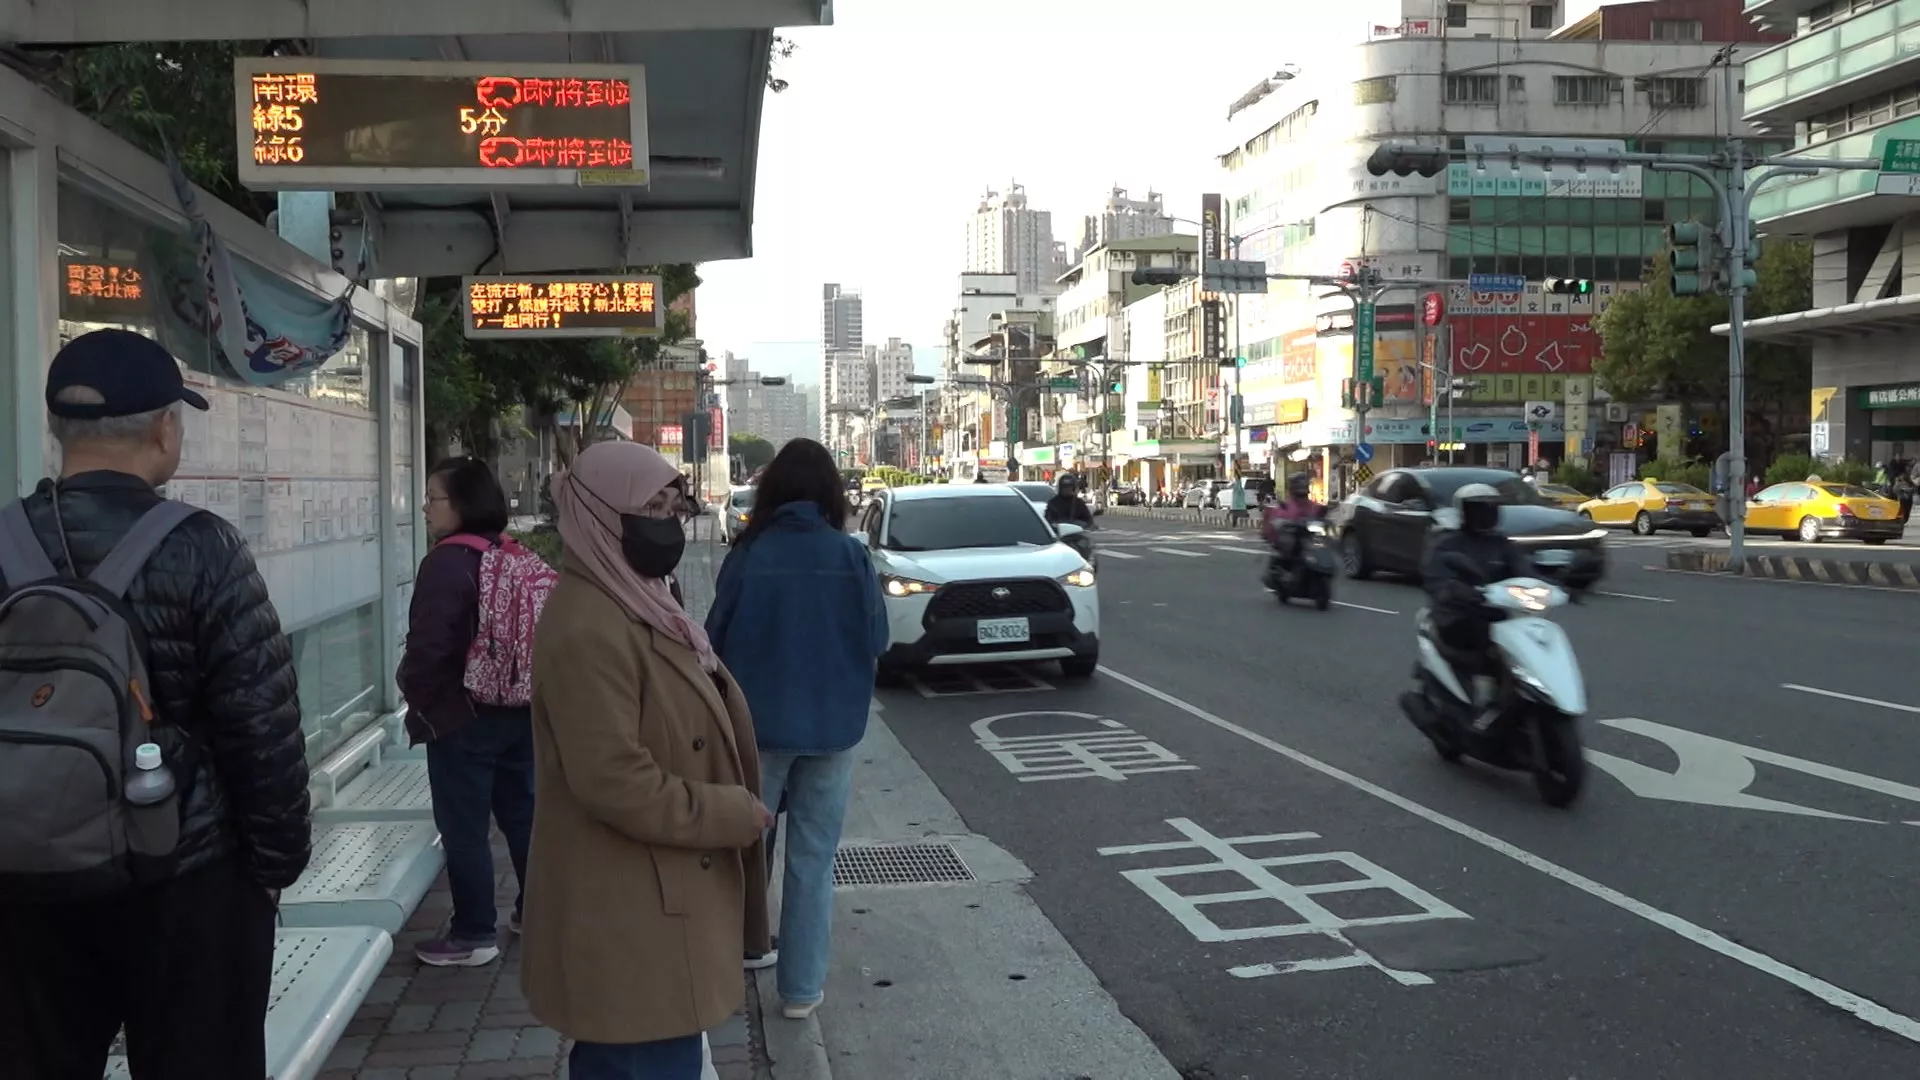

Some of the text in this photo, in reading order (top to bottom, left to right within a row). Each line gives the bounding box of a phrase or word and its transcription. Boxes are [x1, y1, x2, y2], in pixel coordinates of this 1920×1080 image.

[252, 73, 318, 104] 南環
[523, 78, 632, 107] 即將到站
[253, 103, 303, 132] 綠5
[460, 107, 508, 136] 5分
[254, 134, 304, 164] 綠6
[525, 137, 633, 167] 即將到站
